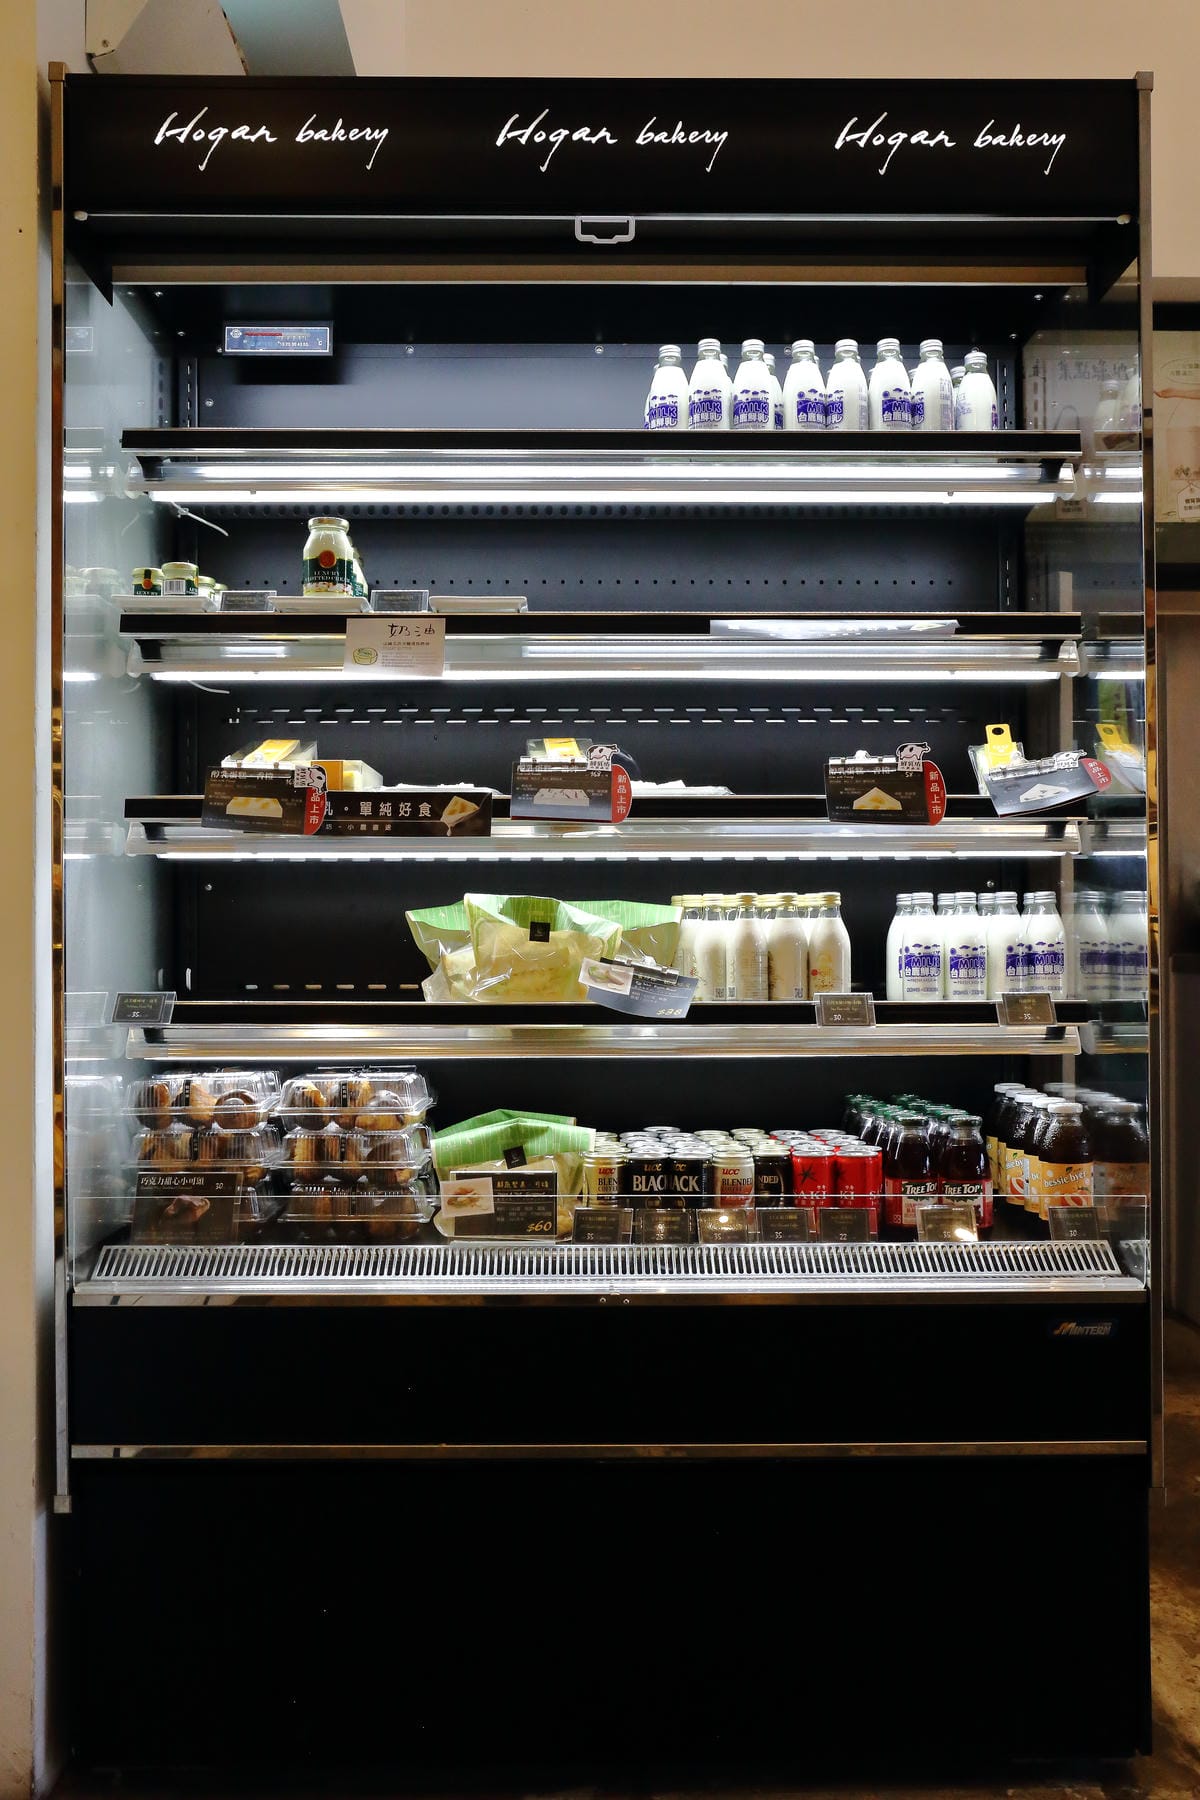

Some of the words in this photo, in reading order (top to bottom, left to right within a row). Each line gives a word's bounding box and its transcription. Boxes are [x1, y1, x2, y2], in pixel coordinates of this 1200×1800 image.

[154, 106, 278, 172] Hogan
[295, 113, 389, 170] bakery
[495, 108, 618, 173] Hogan
[635, 116, 729, 173] bakery
[834, 111, 957, 176] Hogan
[973, 119, 1067, 175] bakery
[739, 401, 768, 415] MILK
[616, 774, 628, 814] 新品上市
[928, 770, 942, 815] 新品上市
[359, 801, 432, 818] 單純好食
[911, 955, 940, 968] MILK
[958, 957, 986, 970] MILK
[905, 1184, 926, 1195] TREE
[943, 1184, 962, 1195] TREE
[526, 1221, 553, 1233] $60
